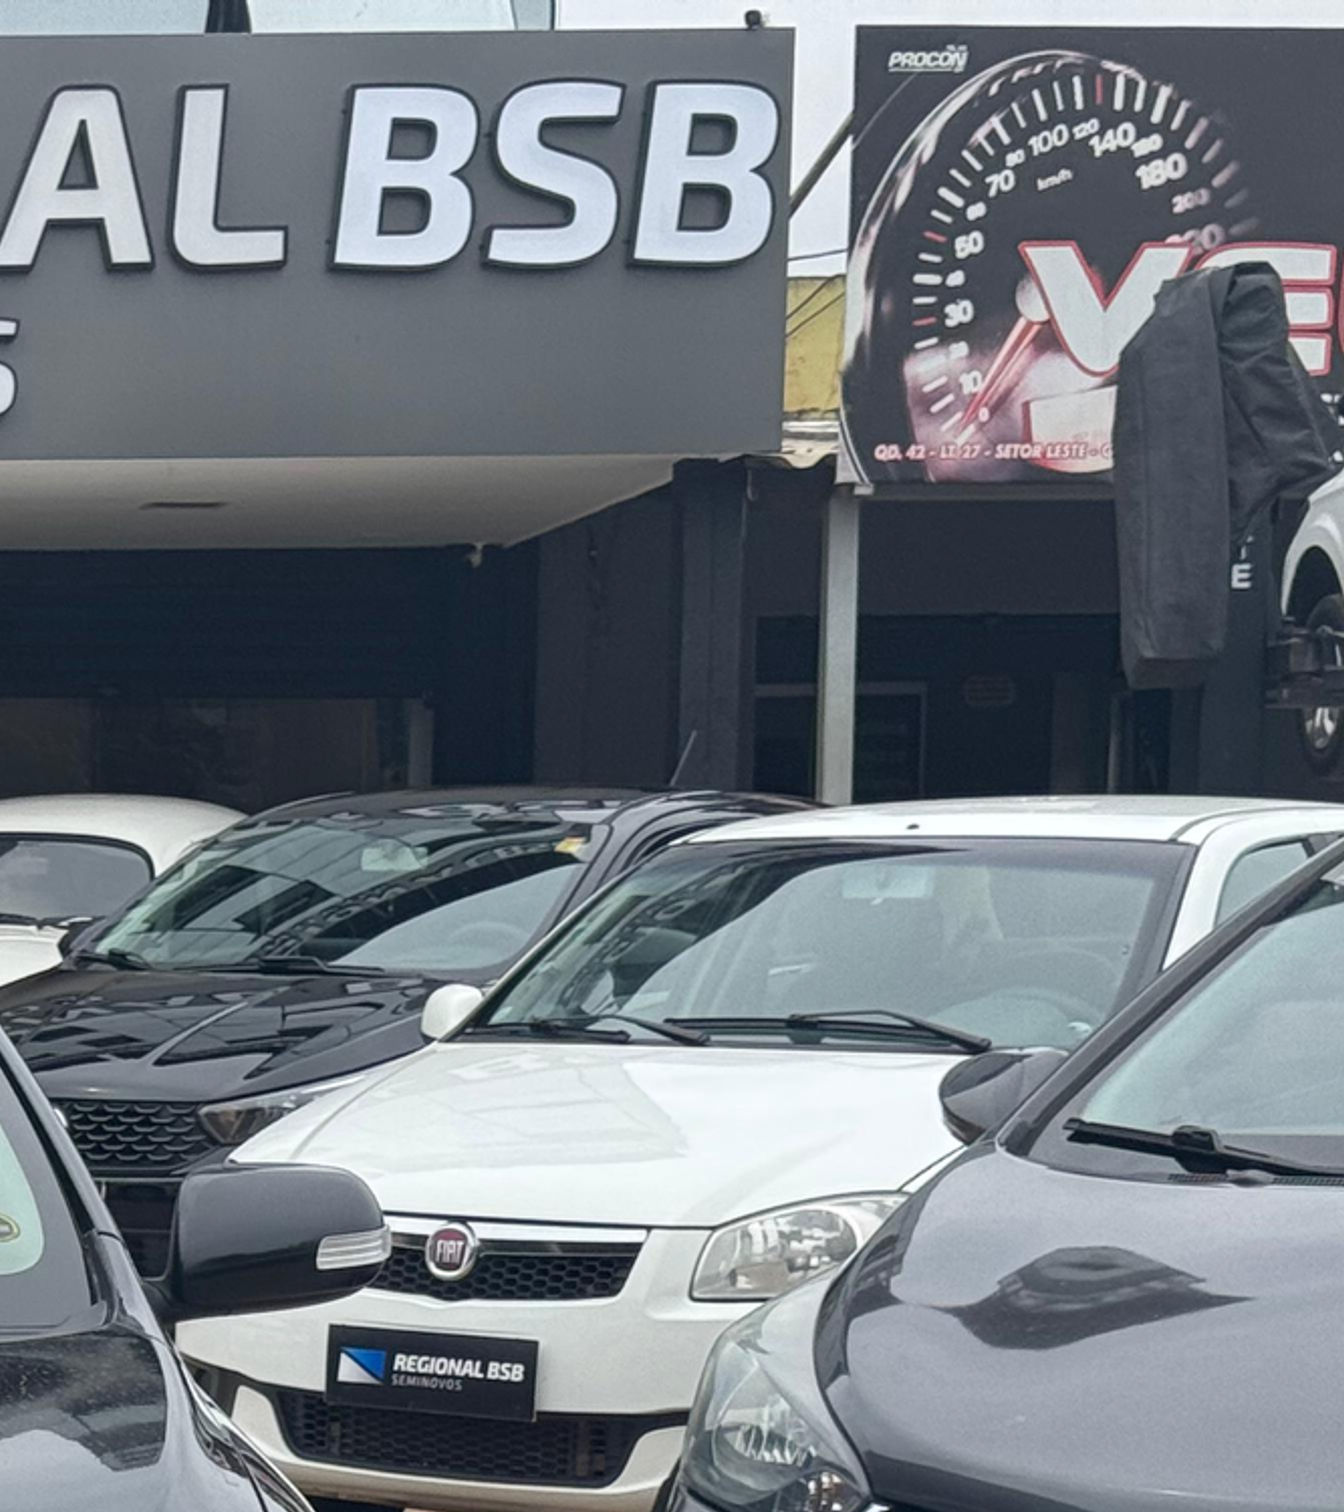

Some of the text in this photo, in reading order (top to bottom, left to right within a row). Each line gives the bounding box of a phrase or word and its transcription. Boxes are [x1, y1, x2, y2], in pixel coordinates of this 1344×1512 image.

[1028, 123, 1070, 156] 100
[1072, 118, 1100, 140] 120
[1089, 122, 1136, 158] 140
[328, 79, 782, 272] BSB
[985, 169, 1015, 197] 70
[1135, 152, 1187, 189] 180
[391, 1374, 463, 1391] SEMINOVOS
[393, 1353, 525, 1382] REGIONAL BSB
